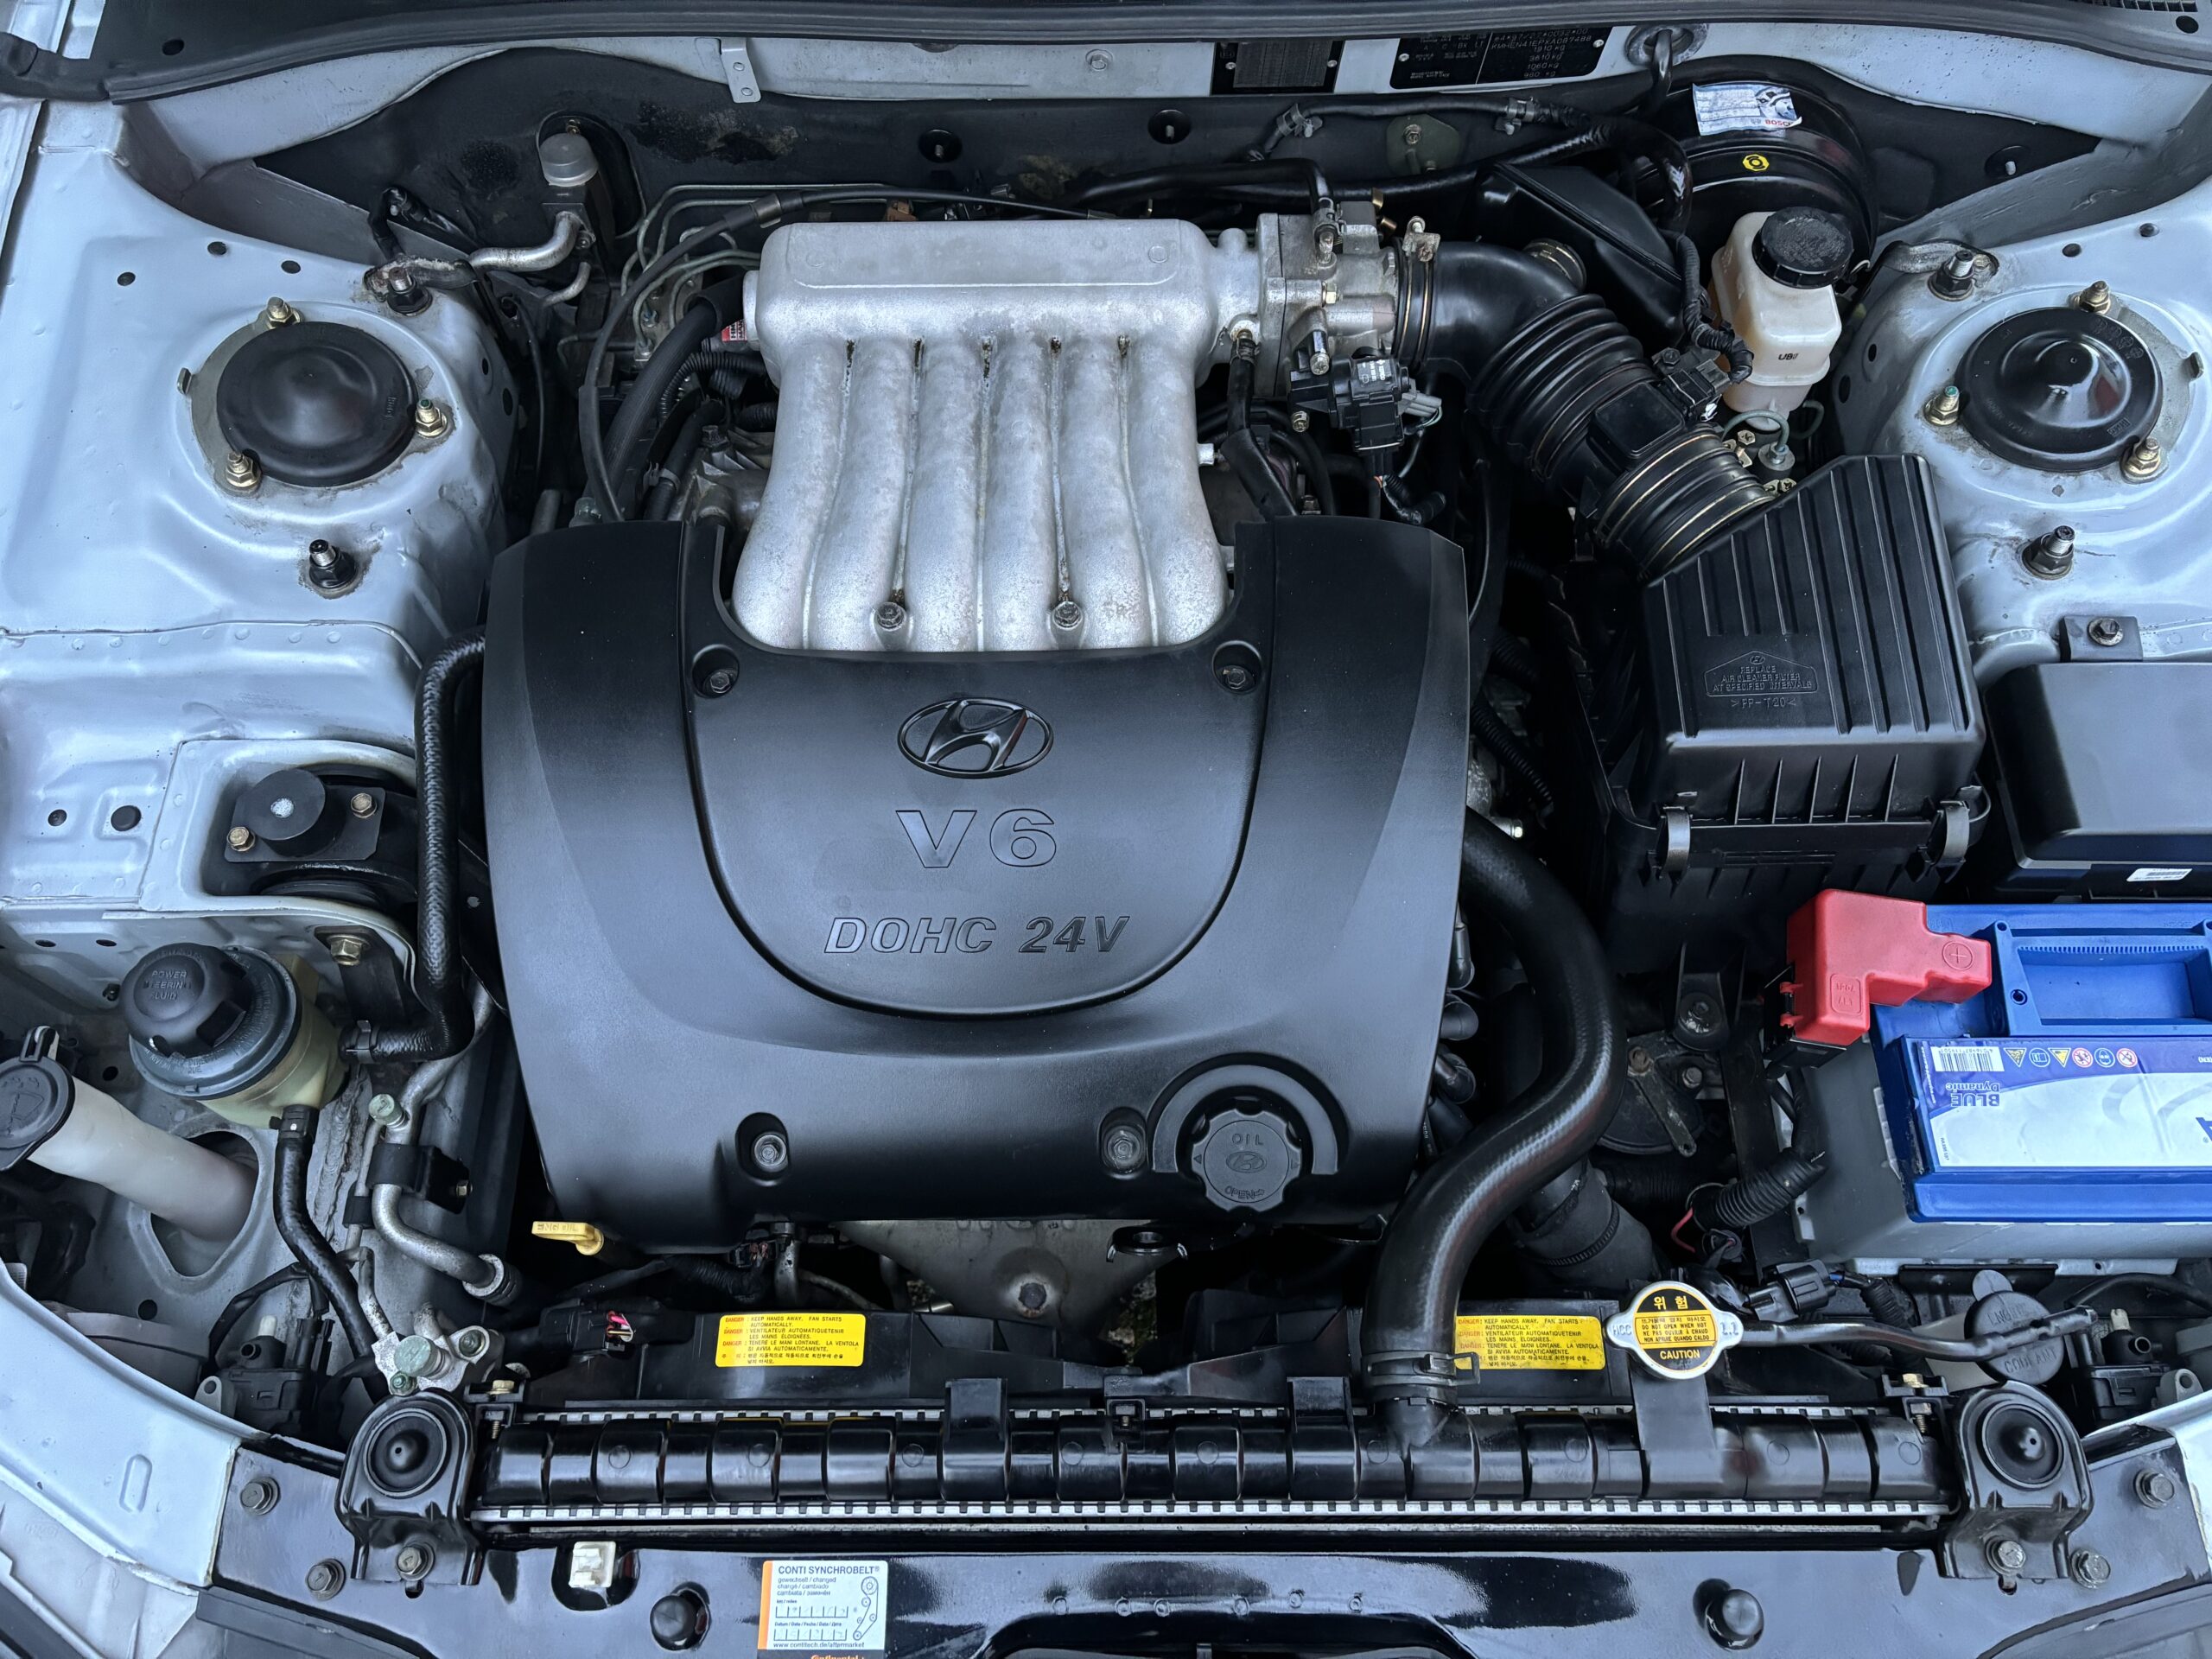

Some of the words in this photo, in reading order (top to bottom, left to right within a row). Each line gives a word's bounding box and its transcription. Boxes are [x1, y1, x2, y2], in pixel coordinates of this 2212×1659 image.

[895, 808, 1057, 868] V6
[823, 917, 997, 954] DOHC
[1018, 916, 1130, 953] 24V
[151, 969, 188, 979] POWER
[1946, 1081, 2001, 1092] Dynamic
[1951, 1093, 2000, 1107] BLUE
[1232, 1133, 1265, 1146] OIL
[537, 1223, 560, 1231] ENG
[1660, 1349, 1701, 1360] CAUTION
[778, 1566, 806, 1574] CONTI
